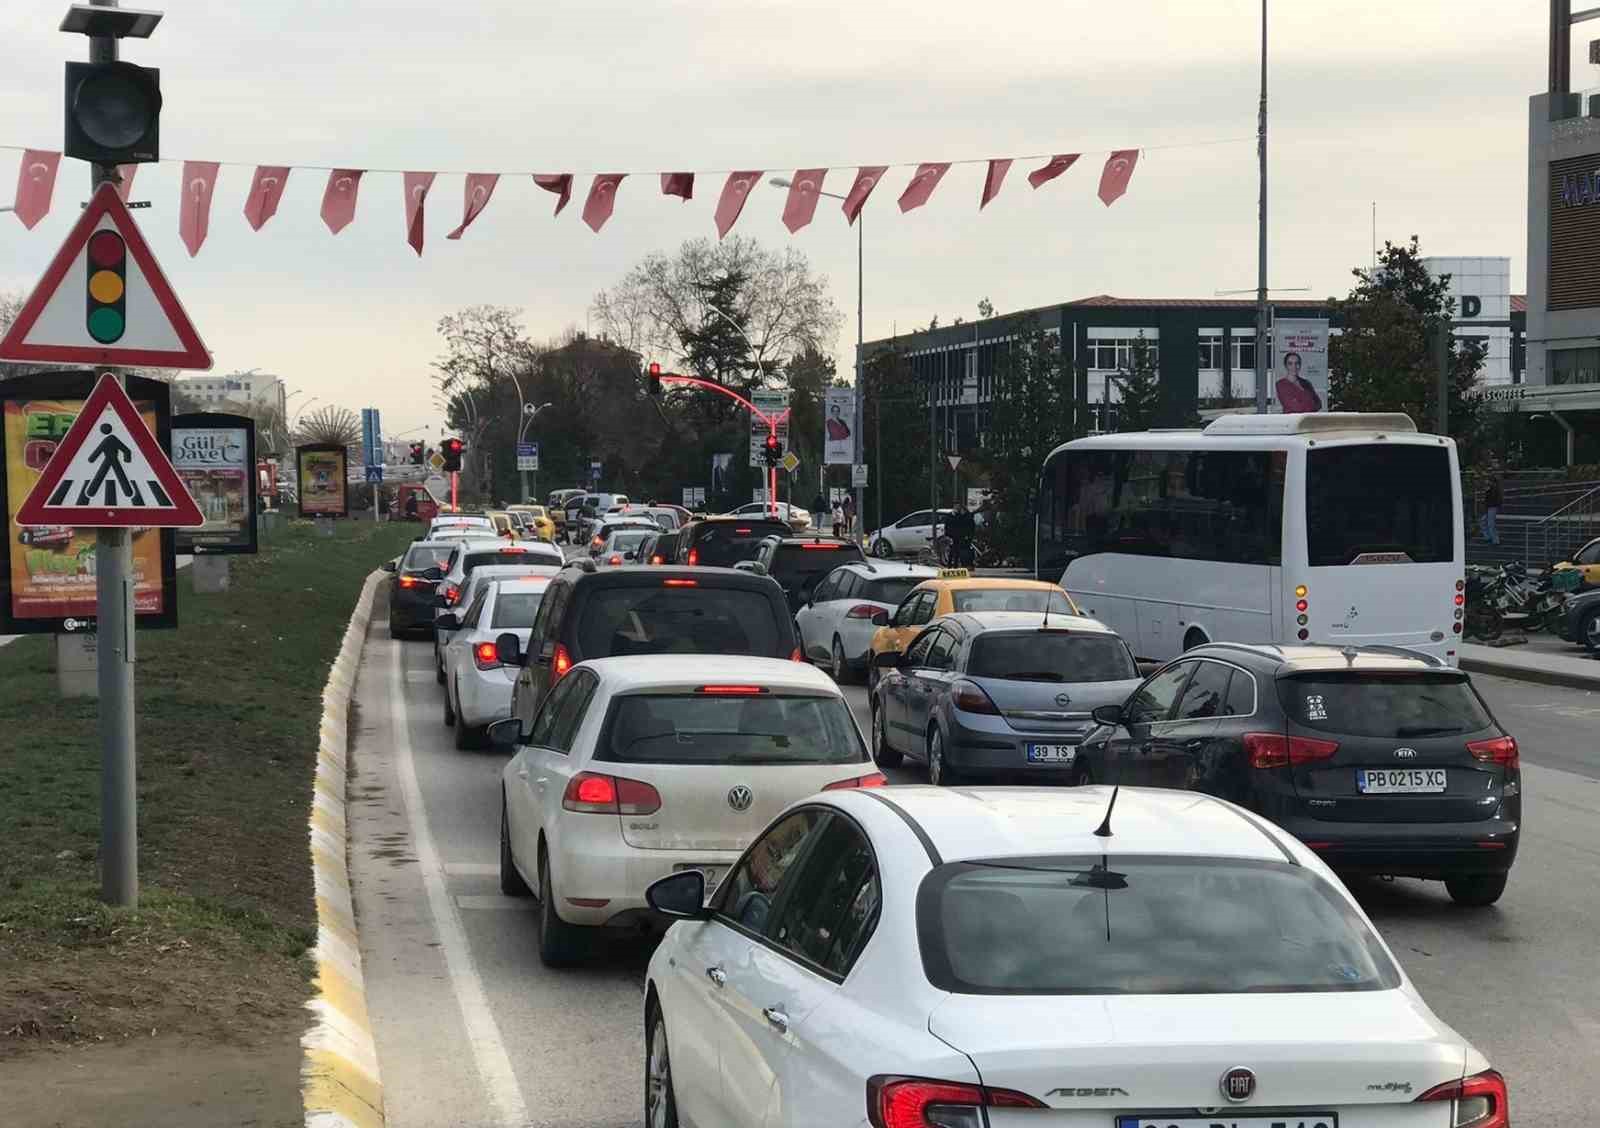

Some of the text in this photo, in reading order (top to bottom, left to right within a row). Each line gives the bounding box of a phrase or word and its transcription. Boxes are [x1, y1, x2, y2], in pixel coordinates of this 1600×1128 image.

[183, 436, 215, 449] Gül
[1034, 746, 1049, 758] 39
[1396, 748, 1416, 759] KIA
[1367, 770, 1445, 787] PB 0215 XC
[1230, 1076, 1250, 1092] FIAT
